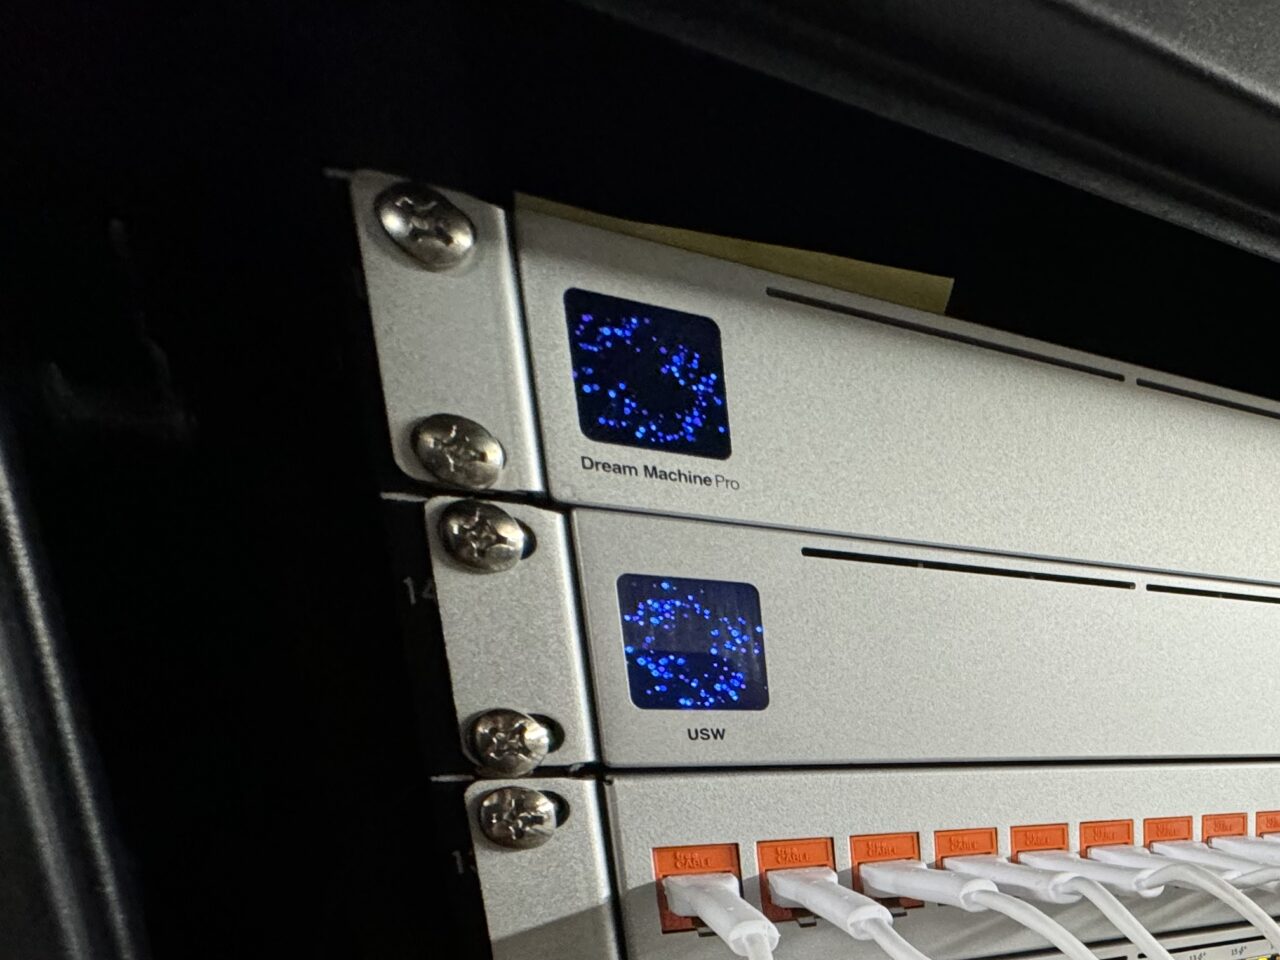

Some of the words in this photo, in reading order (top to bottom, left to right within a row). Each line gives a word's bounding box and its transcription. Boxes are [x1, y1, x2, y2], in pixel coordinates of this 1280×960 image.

[580, 455, 639, 477] Dream
[643, 464, 713, 487] Machine
[714, 474, 740, 491] Pro
[686, 727, 726, 741] USW
